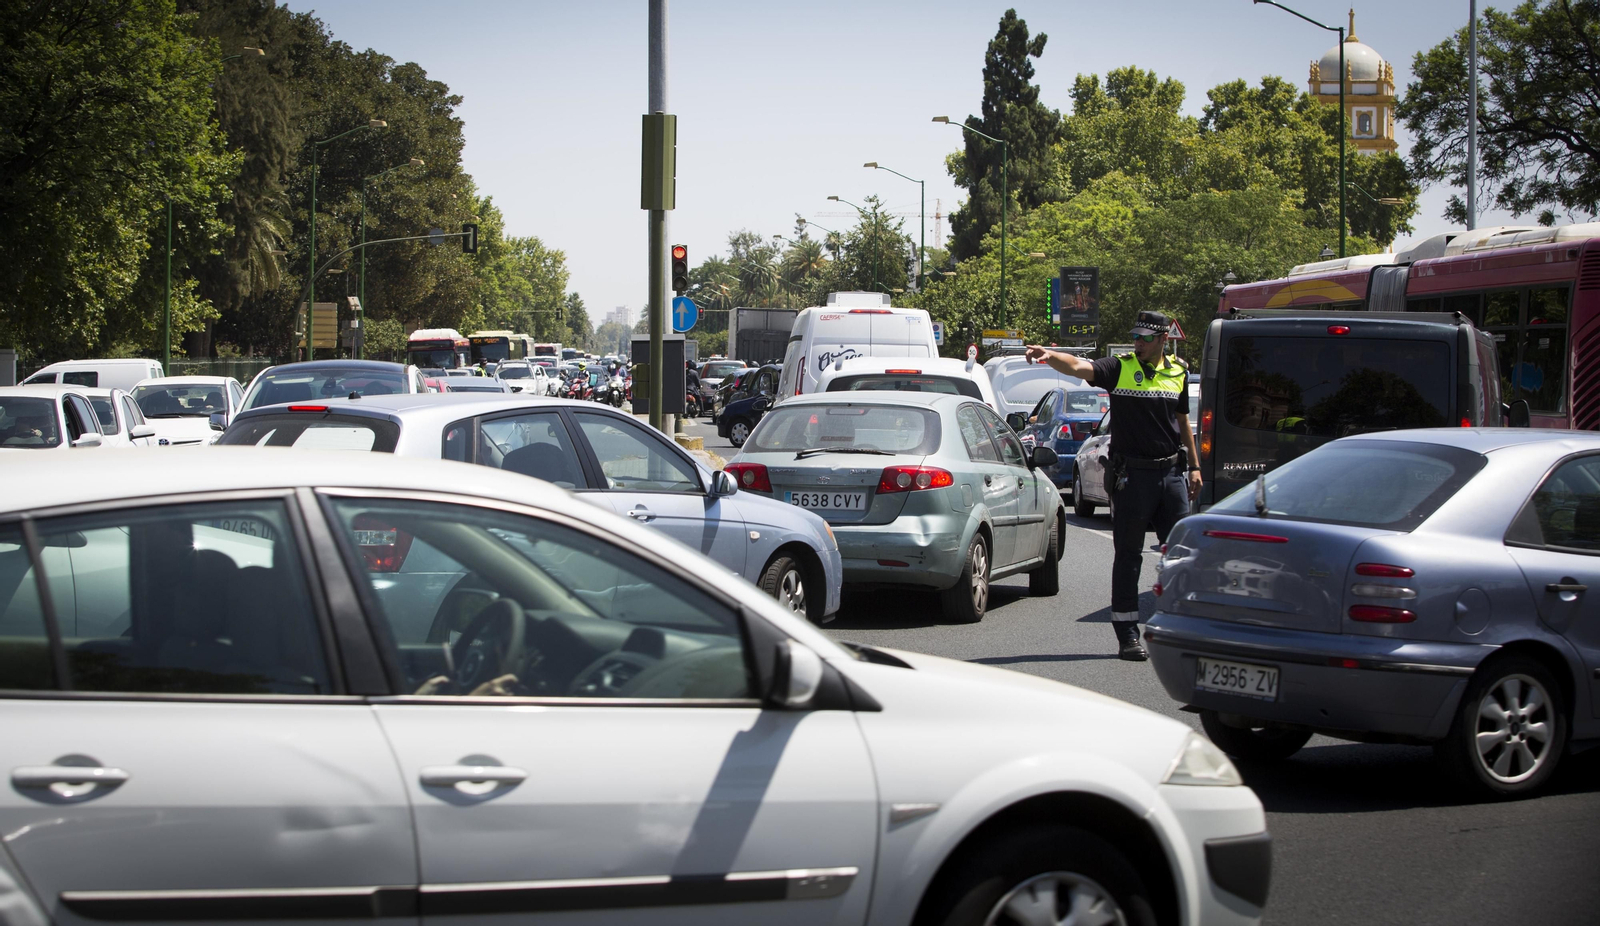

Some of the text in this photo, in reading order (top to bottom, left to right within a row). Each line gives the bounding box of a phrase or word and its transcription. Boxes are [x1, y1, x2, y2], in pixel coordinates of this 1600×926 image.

[1068, 325, 1095, 334] 15:57
[1223, 462, 1266, 471] RENAULT
[791, 493, 862, 508] 5638 CVY
